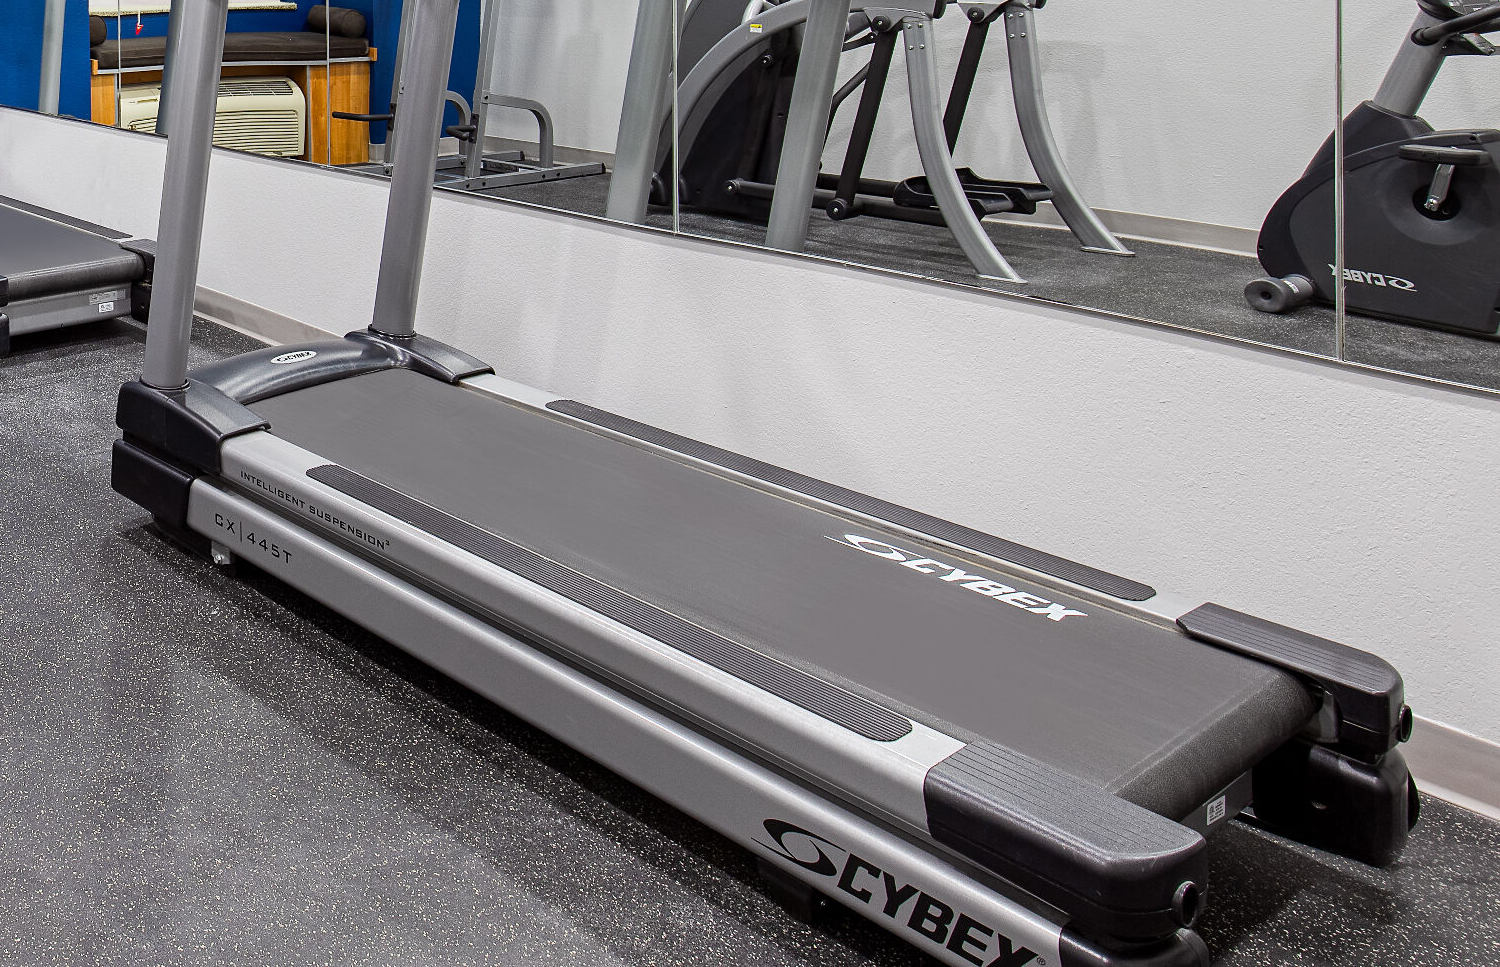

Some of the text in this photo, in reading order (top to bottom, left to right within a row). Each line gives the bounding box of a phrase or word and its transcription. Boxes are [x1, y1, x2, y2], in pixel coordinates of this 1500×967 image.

[240, 470, 305, 508] INTELLIGENT
[900, 559, 1088, 622] CYBEX
[837, 854, 1038, 967] CYBEX
